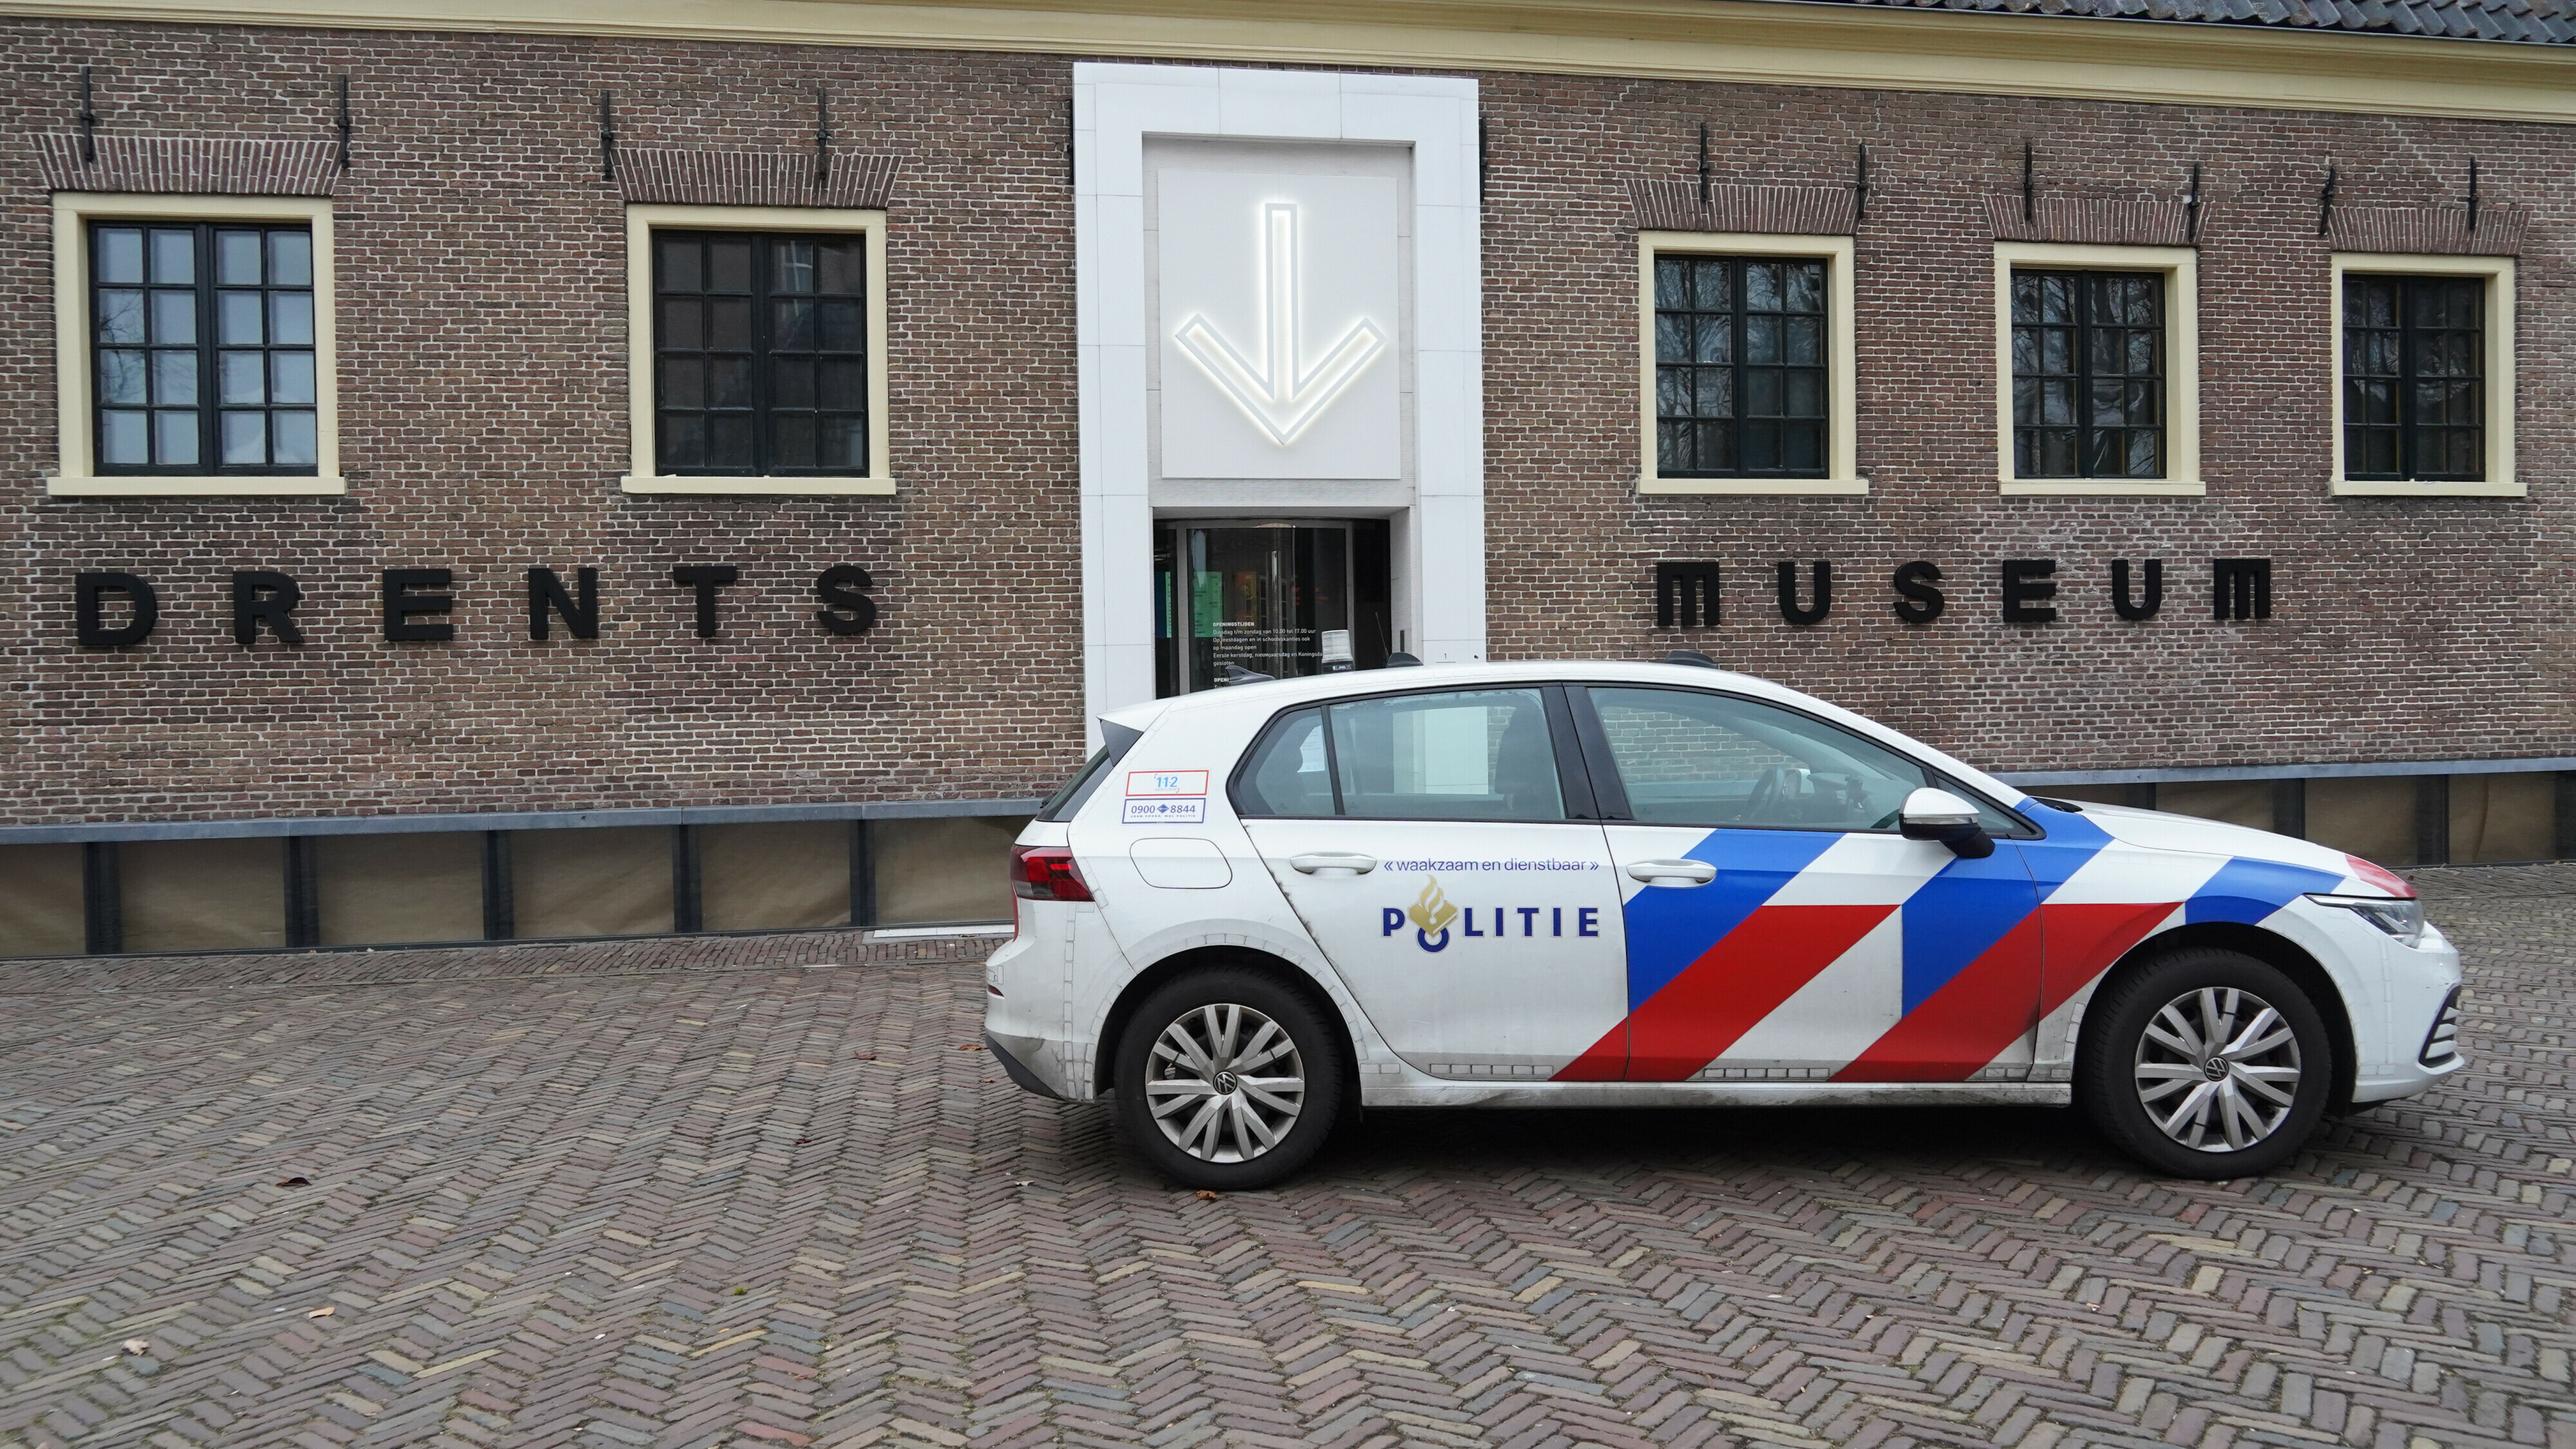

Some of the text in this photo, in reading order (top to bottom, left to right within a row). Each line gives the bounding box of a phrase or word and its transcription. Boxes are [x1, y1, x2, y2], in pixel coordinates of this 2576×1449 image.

[75, 565, 878, 646] DRENTS
[1131, 805, 1196, 813] 0900 8844
[1396, 858, 1479, 871] waakzaam
[1482, 861, 1502, 871] en
[1506, 858, 1586, 871] dienstbaar
[1383, 907, 1599, 953] POLITIE
